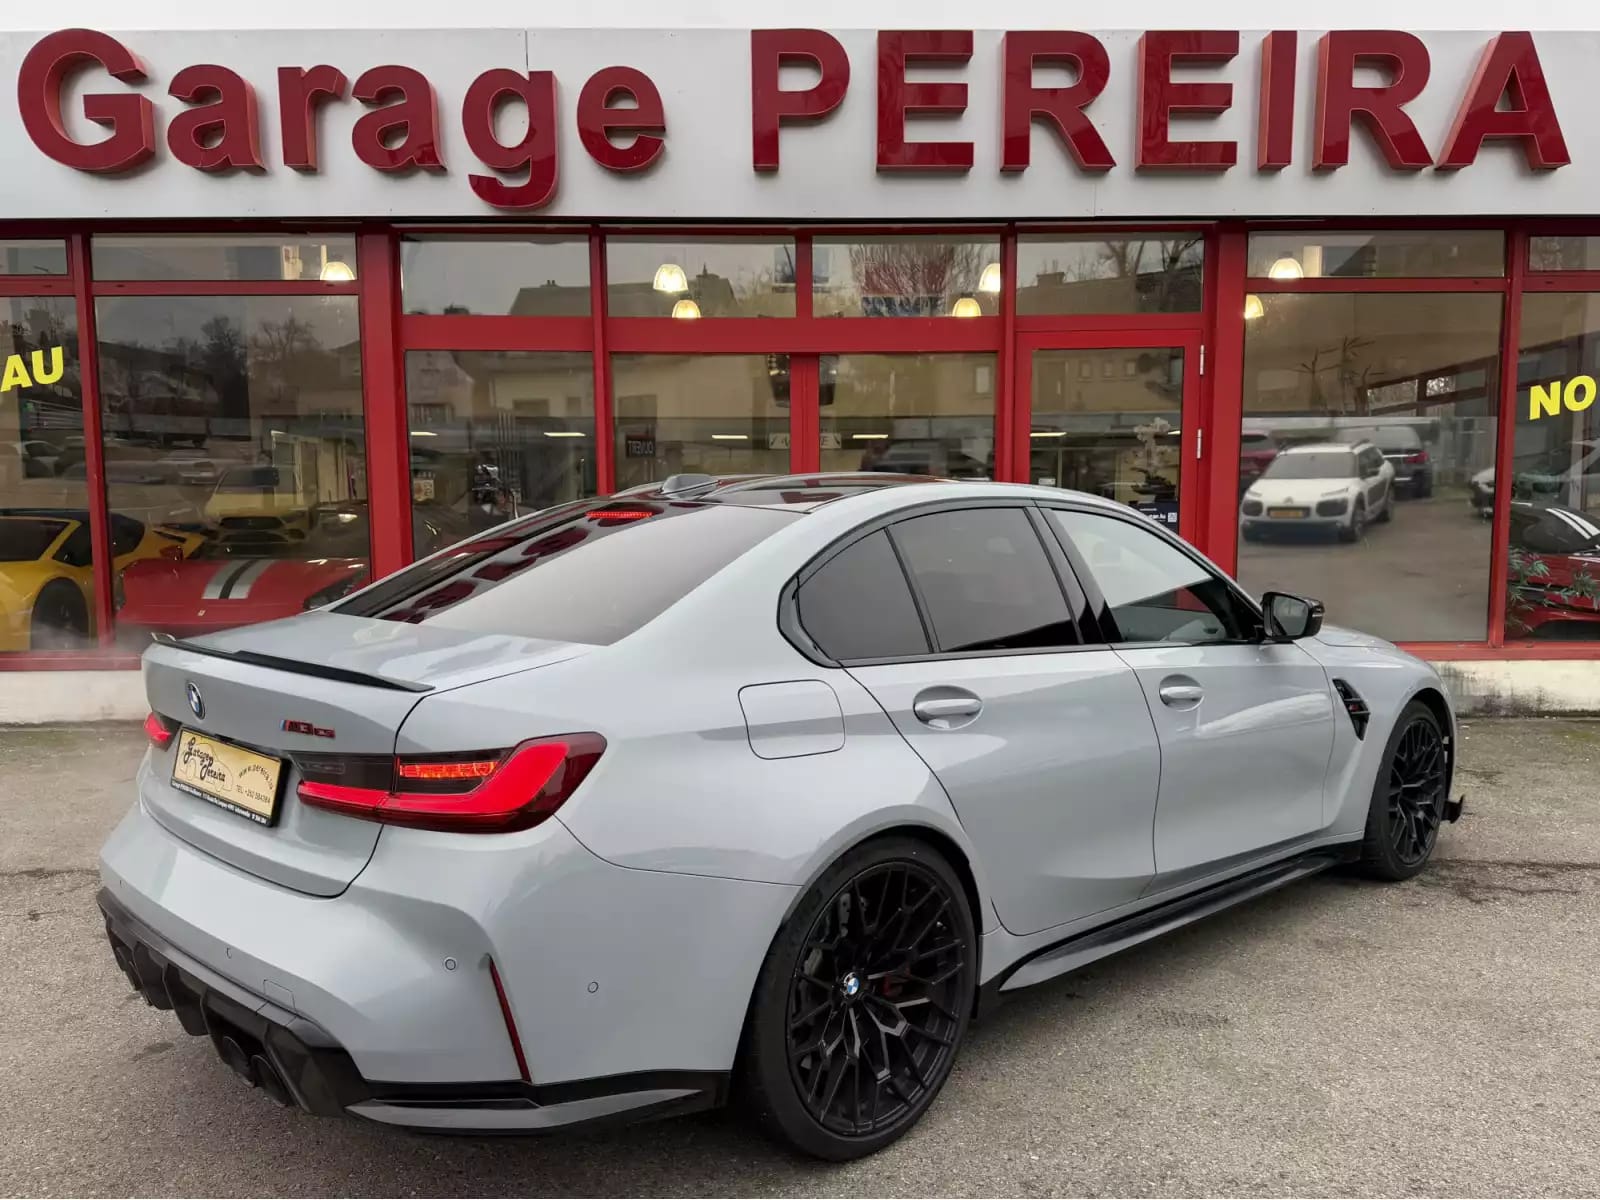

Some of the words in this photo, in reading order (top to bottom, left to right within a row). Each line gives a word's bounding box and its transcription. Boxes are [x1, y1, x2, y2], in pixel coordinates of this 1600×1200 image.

[17, 28, 667, 209] Garage
[751, 29, 1572, 172] PEREIRA
[0, 346, 64, 392] AU
[1529, 375, 1597, 420] NO
